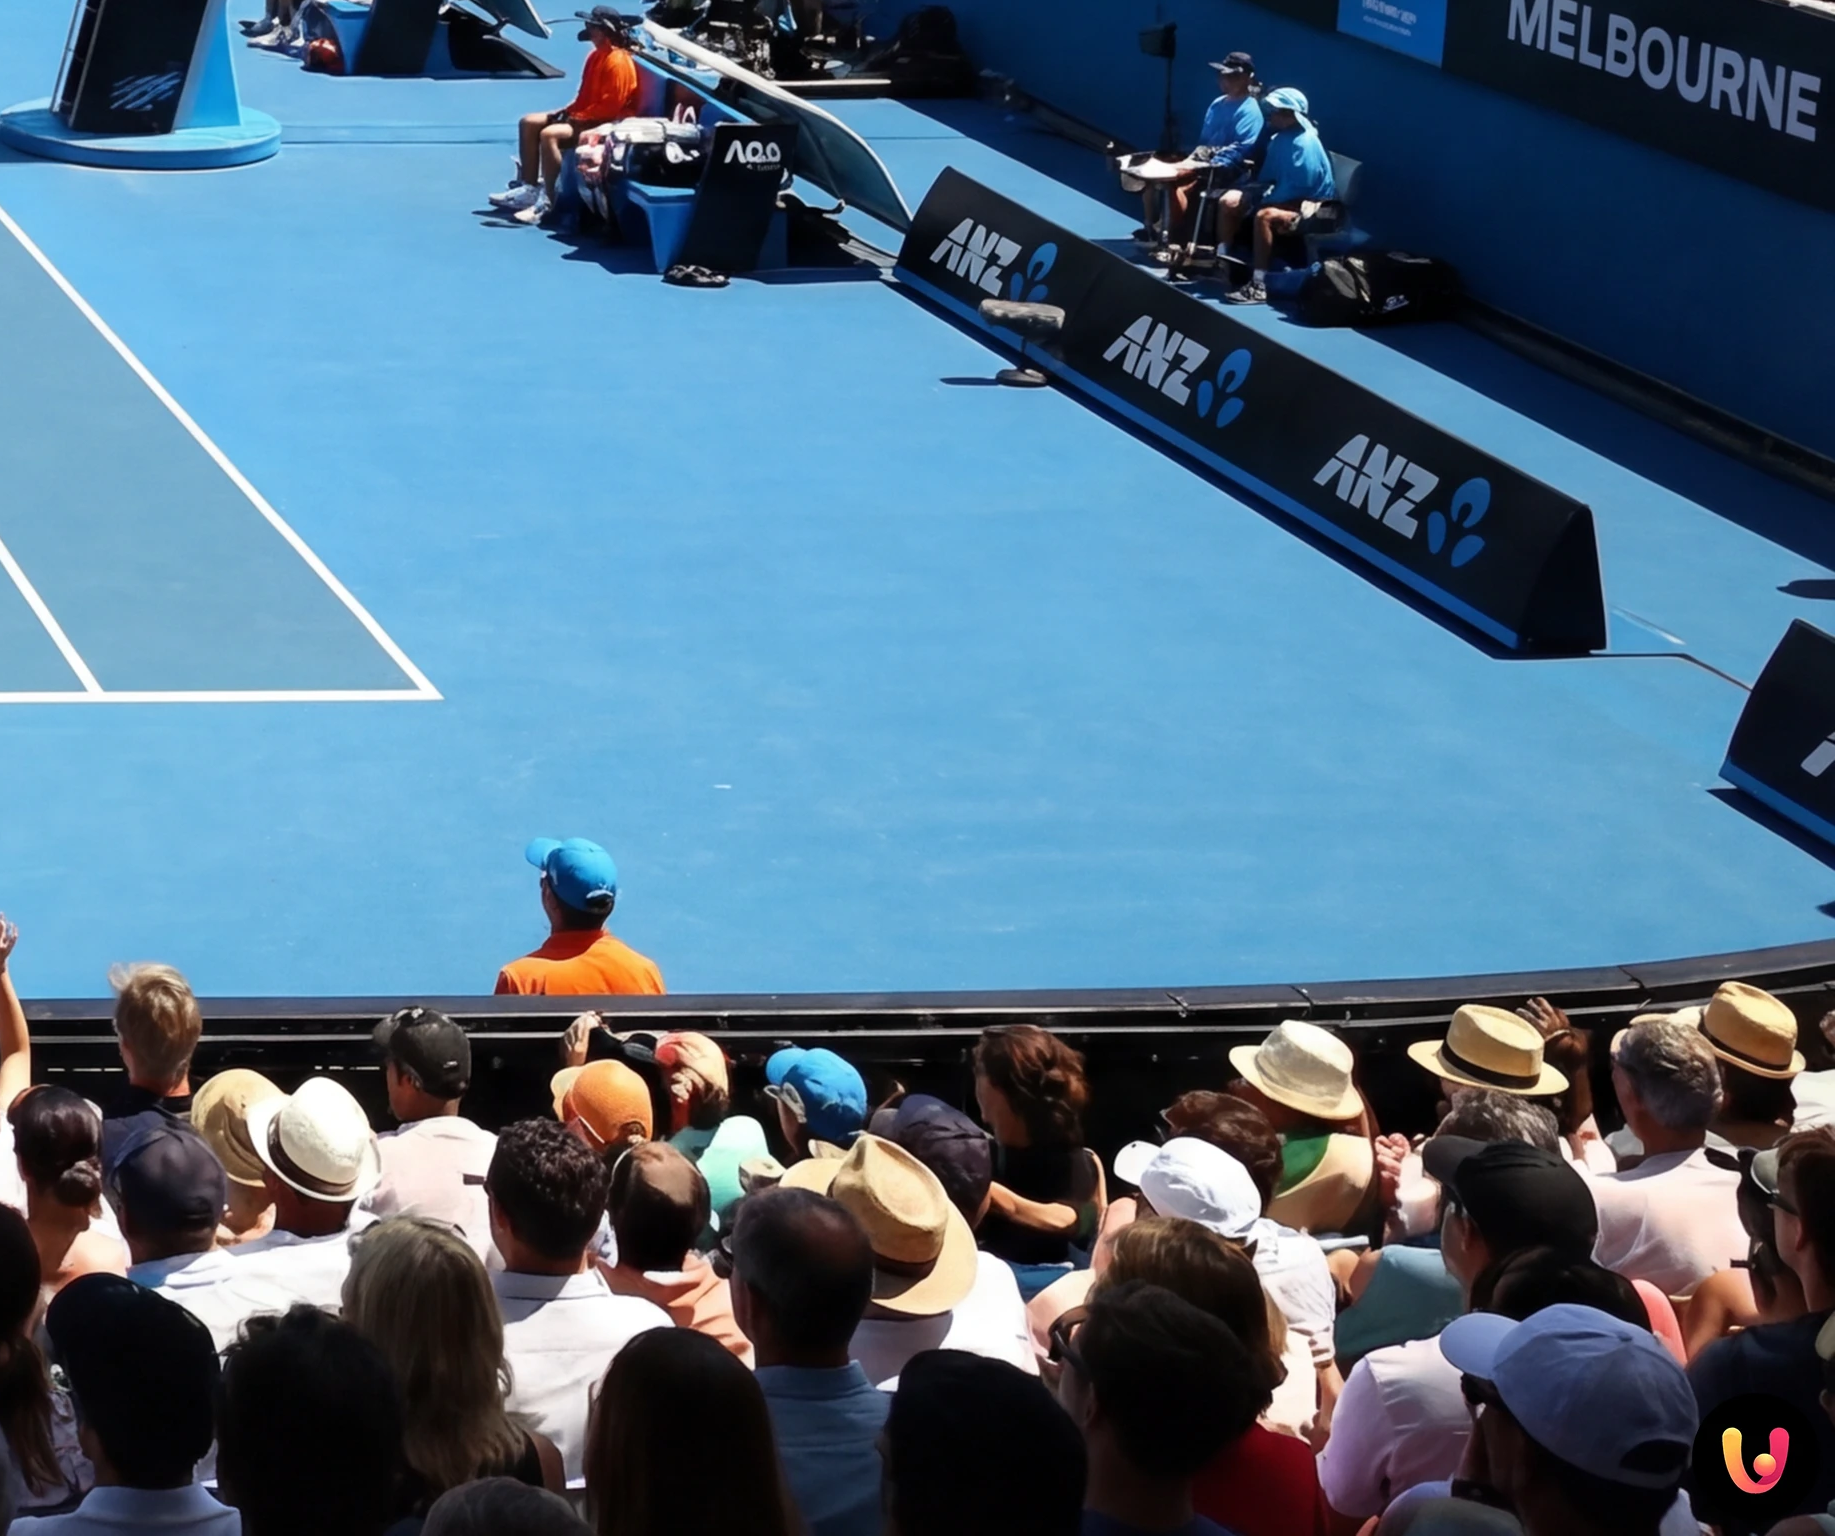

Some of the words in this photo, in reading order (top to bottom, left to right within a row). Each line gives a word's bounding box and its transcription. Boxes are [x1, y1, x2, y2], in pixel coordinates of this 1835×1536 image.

[930, 217, 1022, 297] ANZ
[1102, 314, 1211, 406] ANZ
[1312, 433, 1440, 540] ANZ
